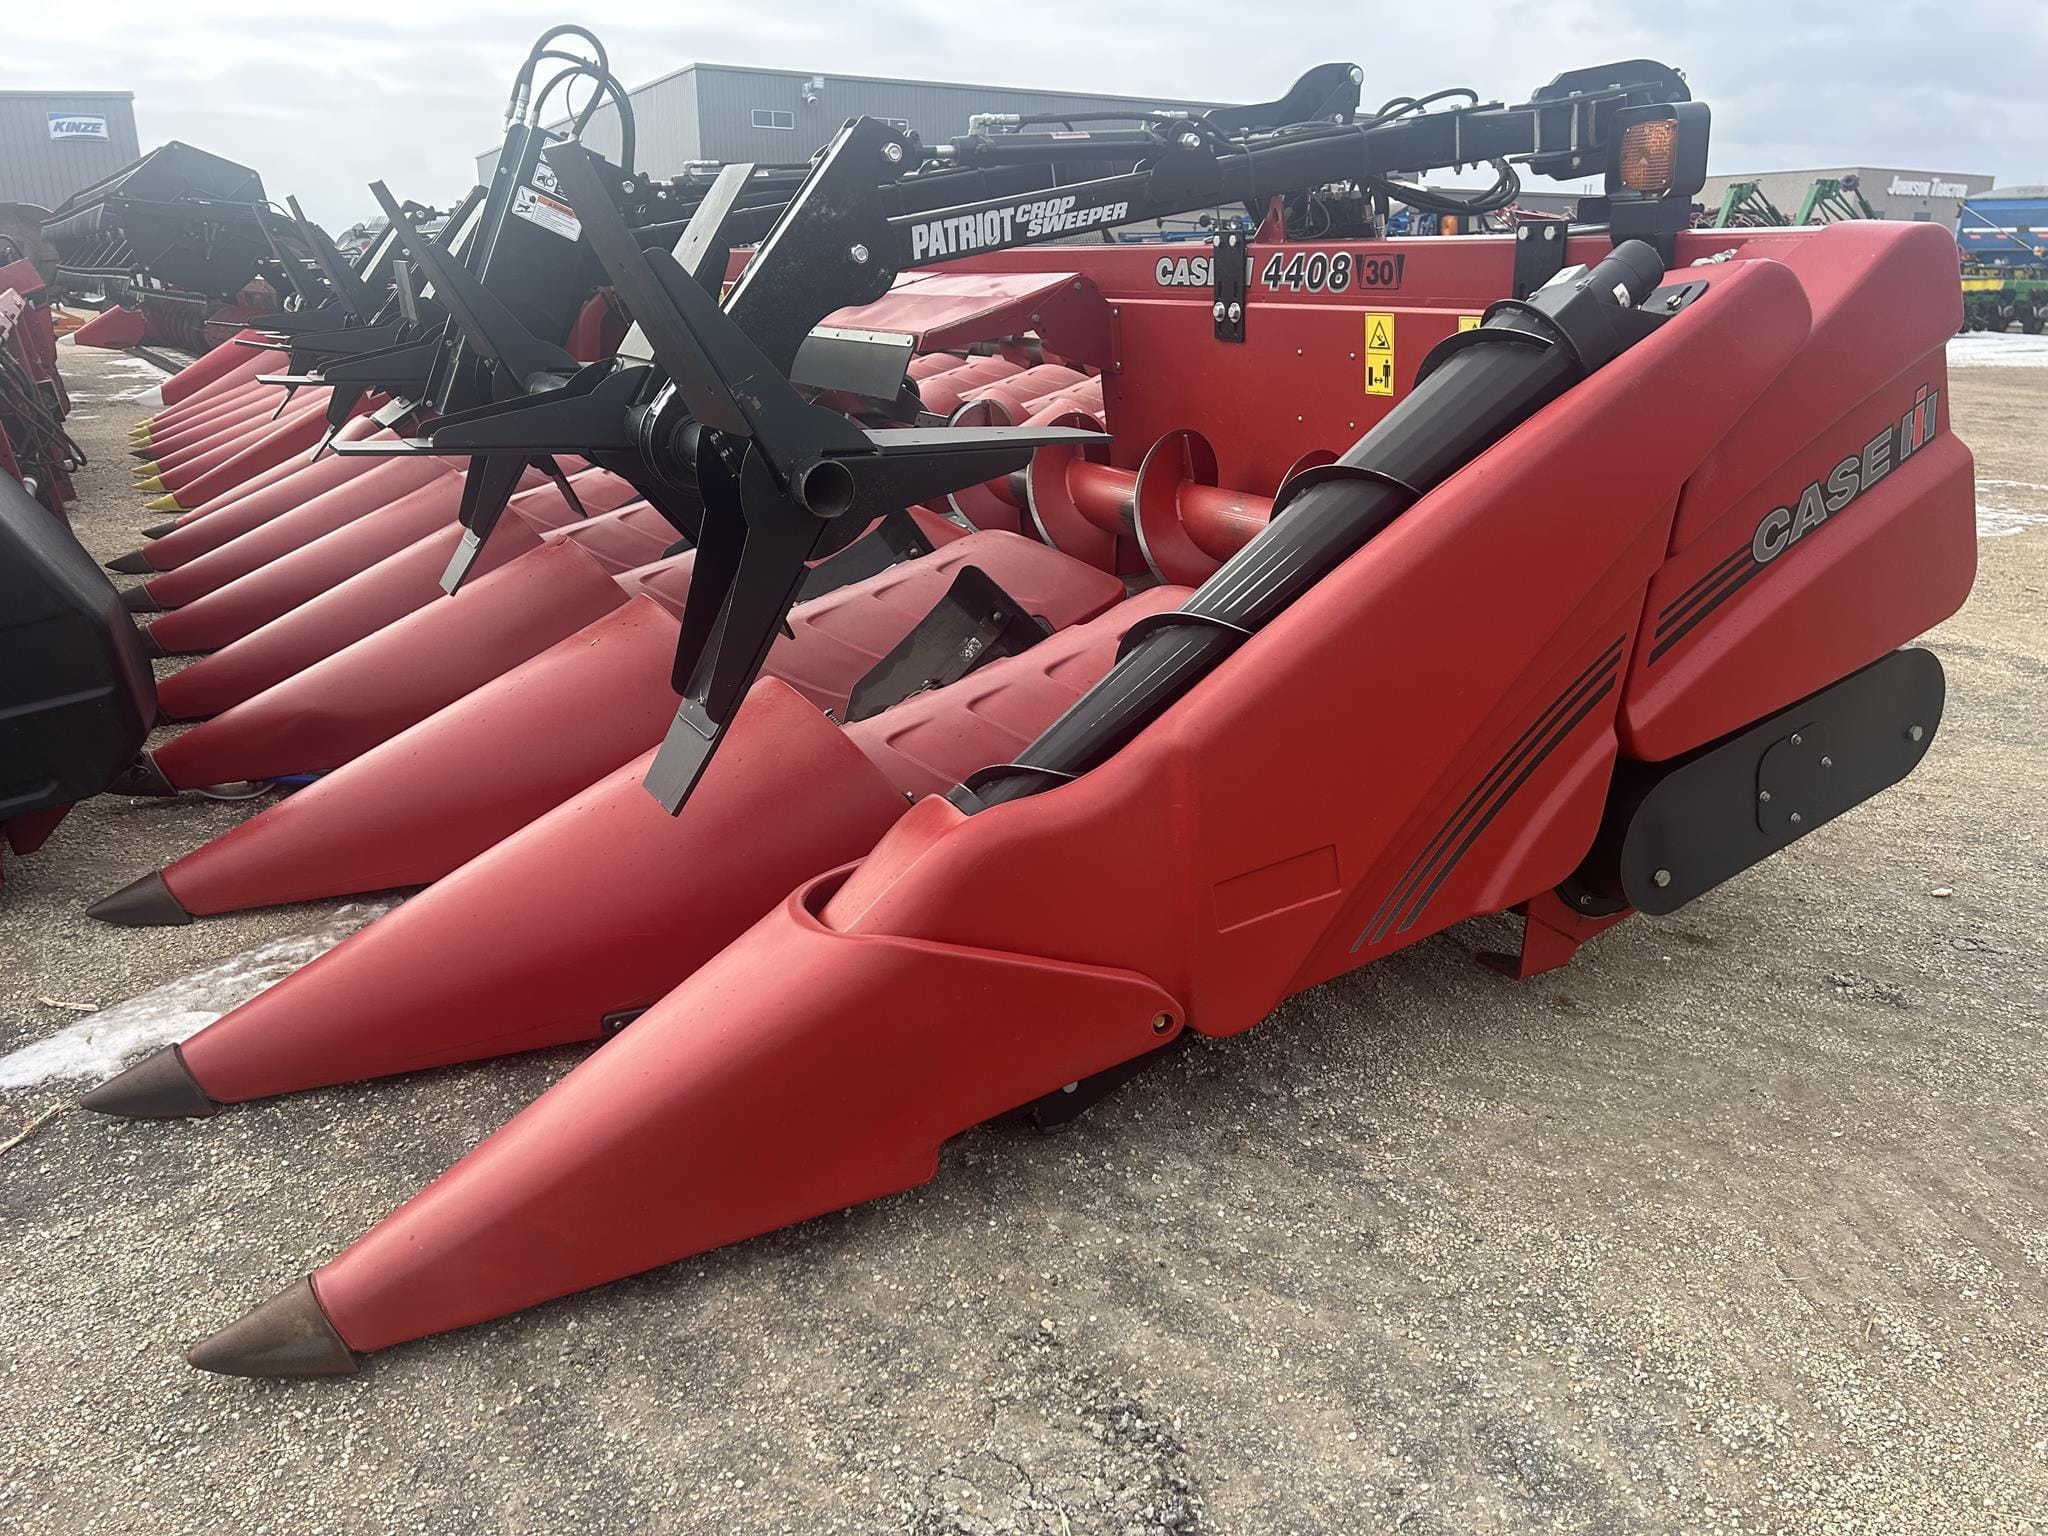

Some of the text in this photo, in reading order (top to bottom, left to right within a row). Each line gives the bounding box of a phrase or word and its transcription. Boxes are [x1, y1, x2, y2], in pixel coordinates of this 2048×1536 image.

[53, 120, 103, 133] KINZE
[911, 195, 1076, 260] PATRIOT CROP
[1026, 201, 1129, 238] SWEEPER
[1260, 251, 1353, 293] 4408
[1365, 259, 1395, 287] 30
[1752, 426, 1893, 564] CASE
